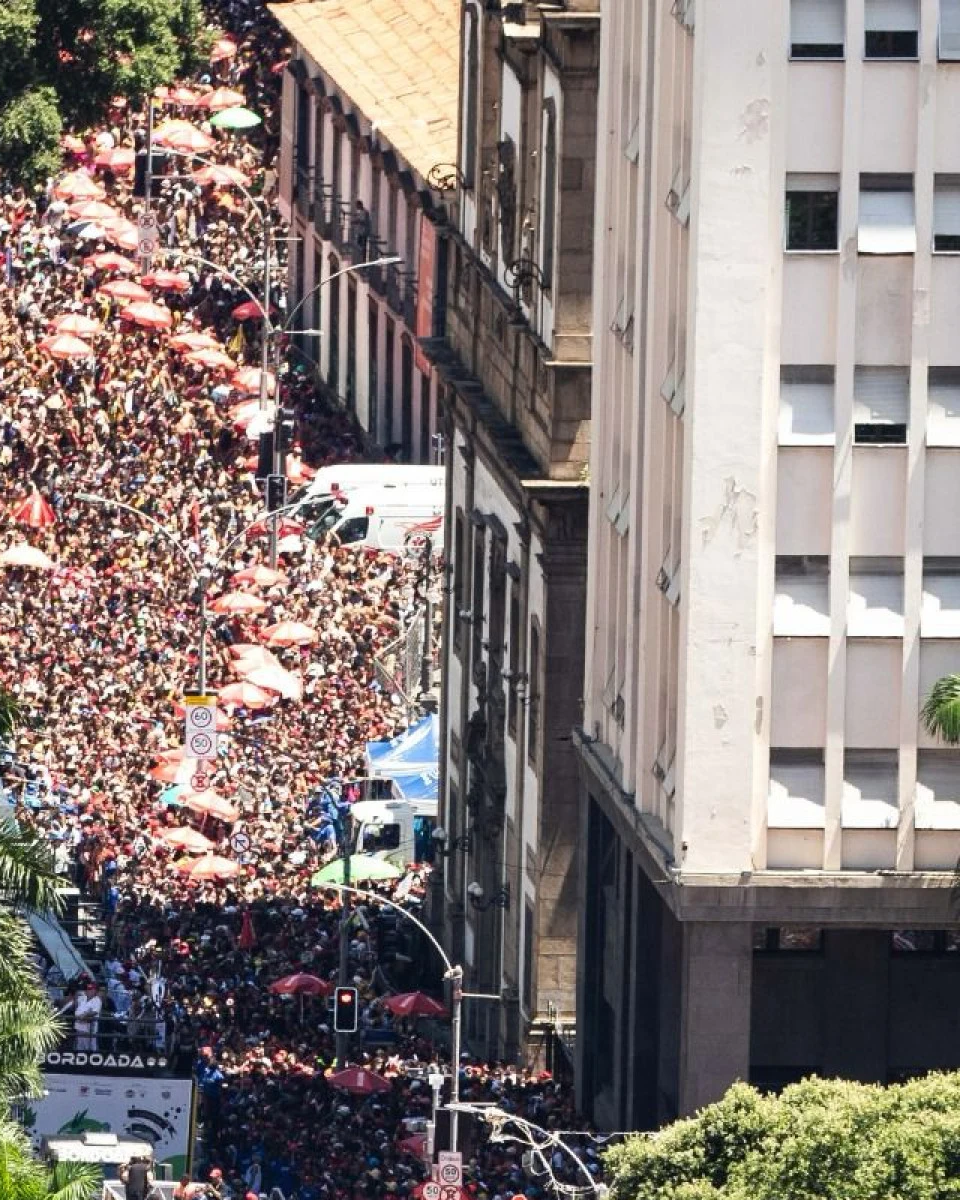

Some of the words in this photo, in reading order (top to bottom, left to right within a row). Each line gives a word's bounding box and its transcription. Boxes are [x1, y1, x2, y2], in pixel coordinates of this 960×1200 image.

[194, 712, 208, 721] 60
[194, 738, 208, 748] 50
[426, 1186, 439, 1194] 50
